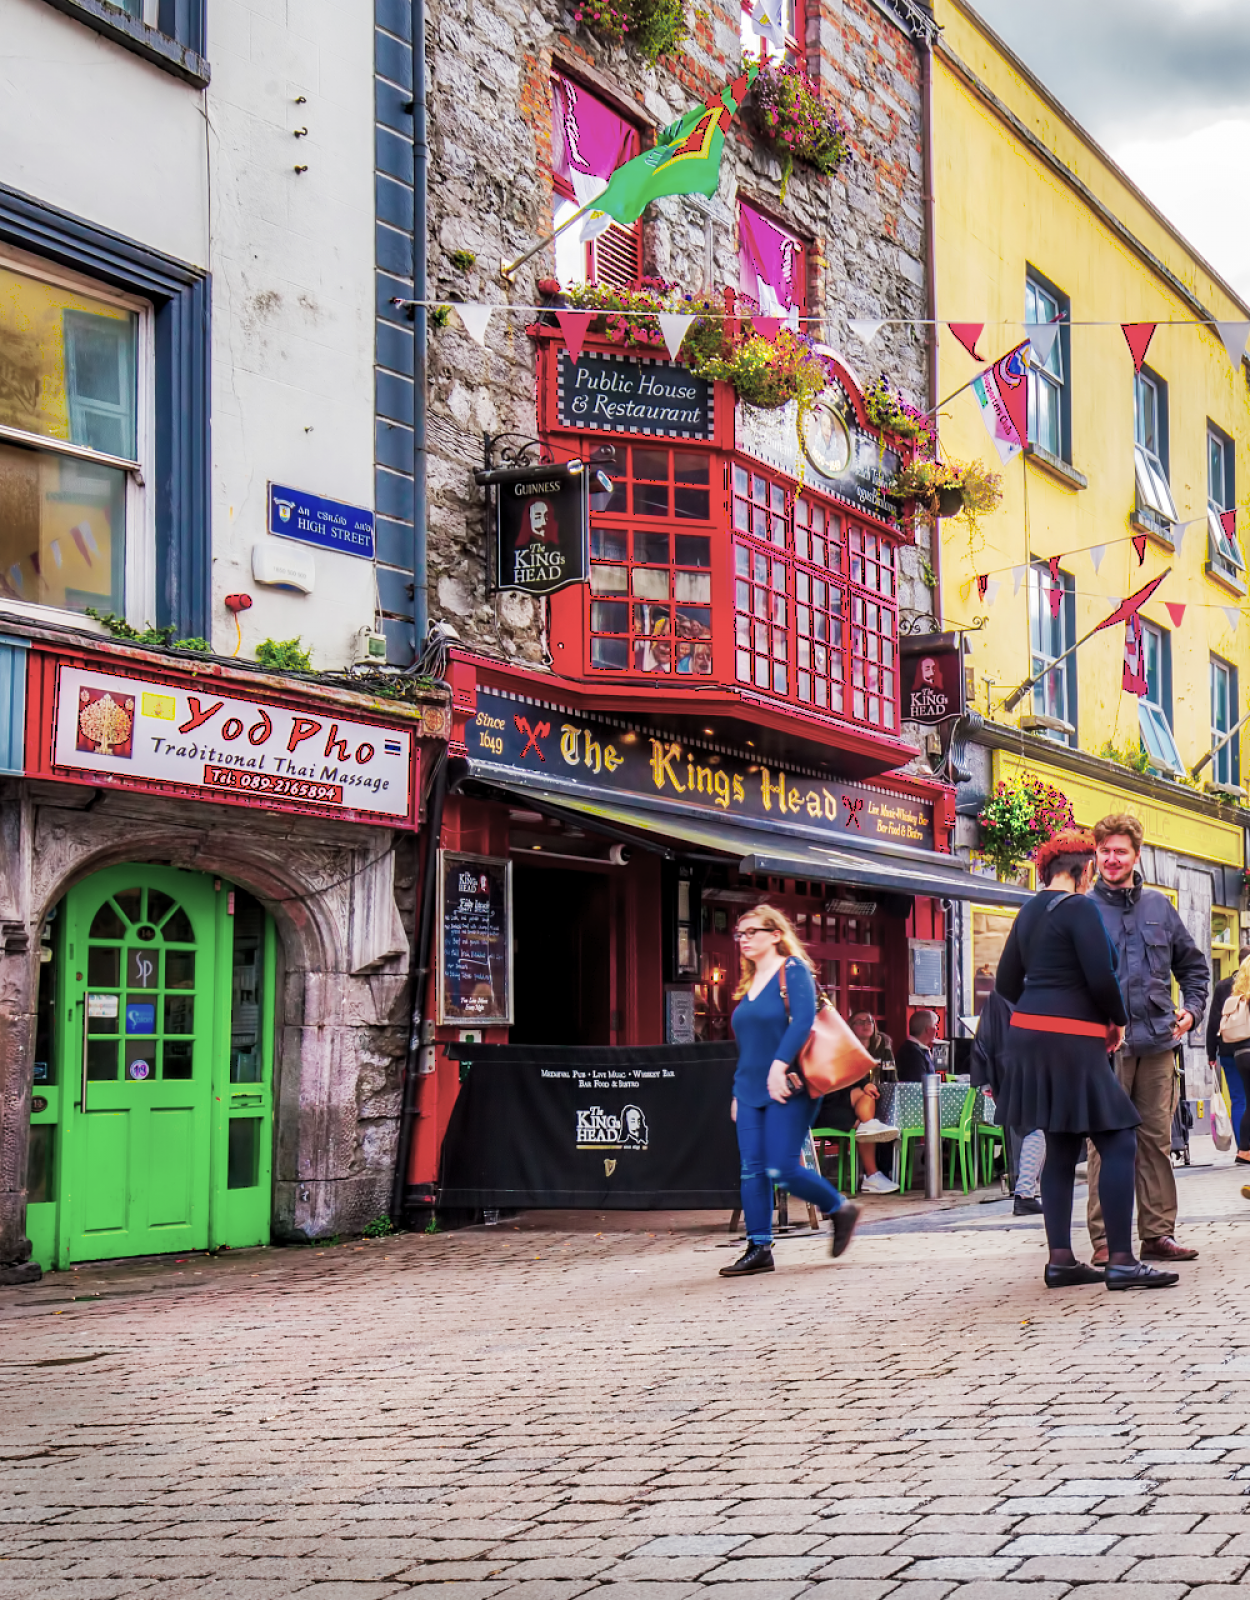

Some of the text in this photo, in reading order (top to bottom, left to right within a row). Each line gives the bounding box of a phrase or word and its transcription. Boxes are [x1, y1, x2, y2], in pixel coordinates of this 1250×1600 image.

[575, 368, 696, 400] Public House
[571, 394, 701, 423] & Restaurant
[515, 481, 561, 496] GUINNESS
[298, 517, 371, 547] HIGH STREET
[514, 566, 562, 583] HEAD
[475, 712, 506, 731] Since
[910, 704, 946, 717] HEAD
[179, 696, 376, 765] Yod Pho
[479, 730, 504, 755] 1649
[151, 737, 390, 793] Traditional Thai Massage
[211, 769, 236, 785] Tel:
[560, 723, 837, 822] The Kings Head
[576, 1128, 618, 1142] HEAD
